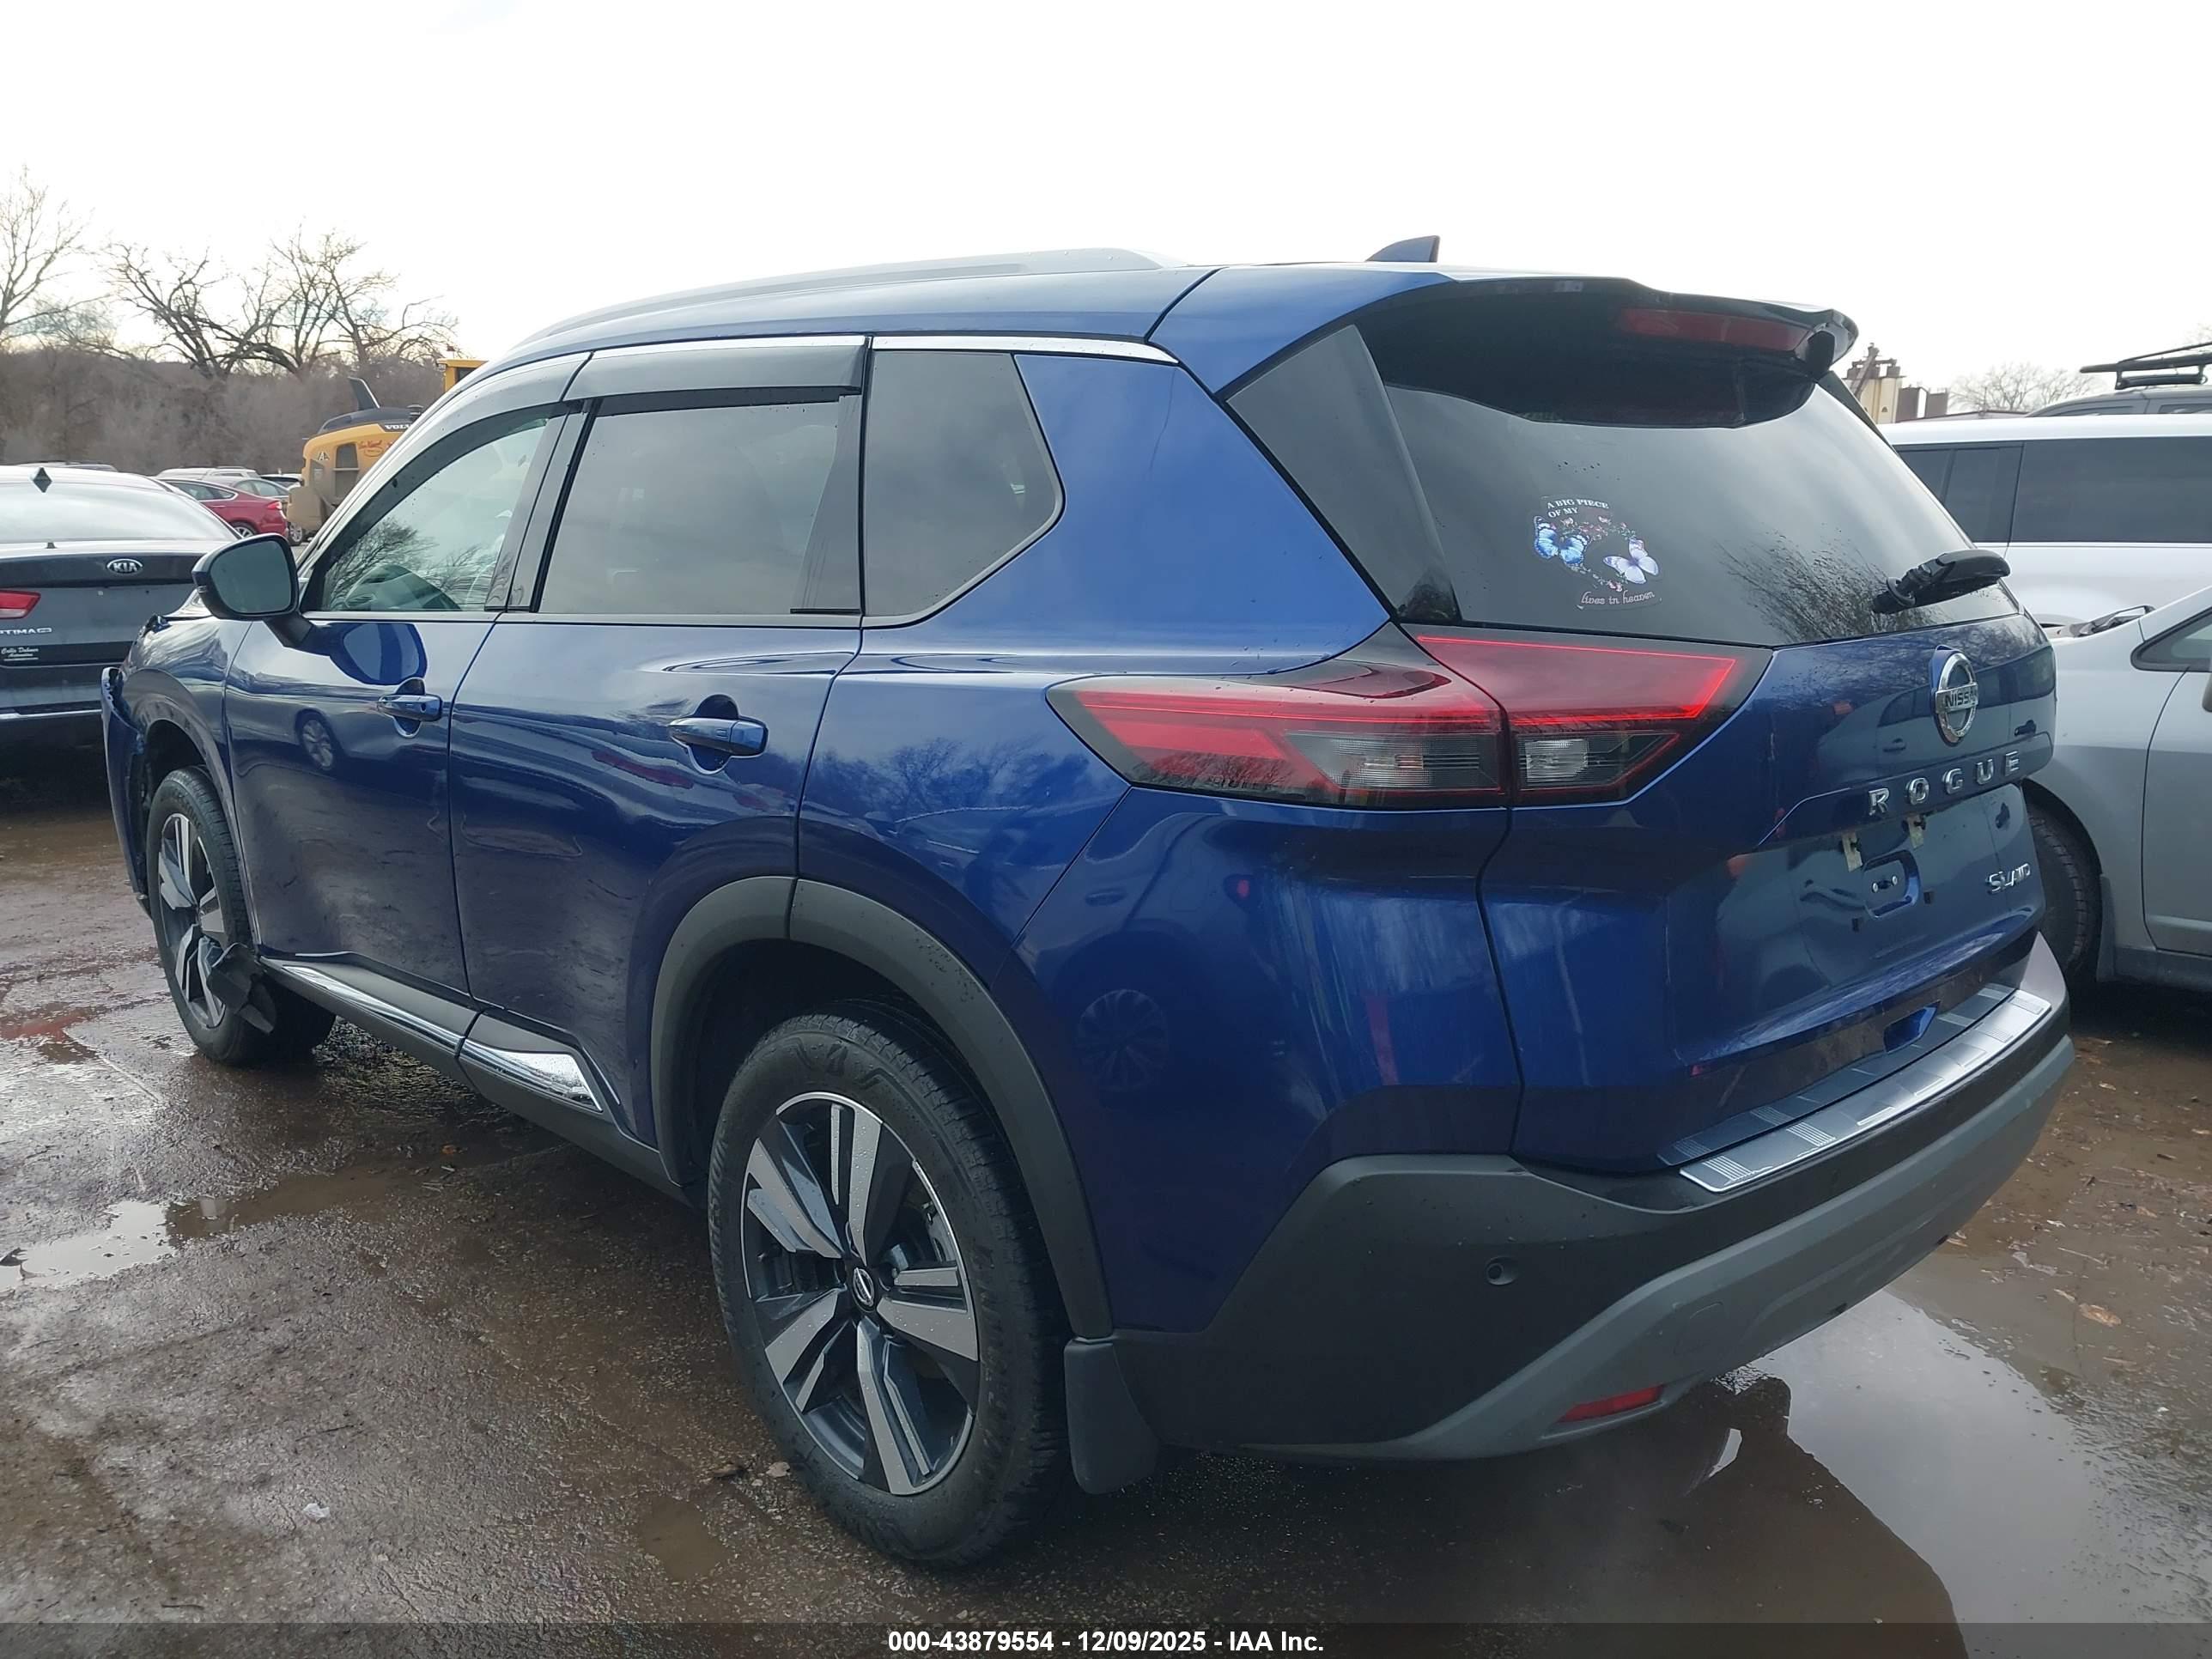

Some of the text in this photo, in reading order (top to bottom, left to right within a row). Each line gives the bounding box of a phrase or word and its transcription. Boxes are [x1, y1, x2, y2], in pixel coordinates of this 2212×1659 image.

[1577, 499, 1609, 509] PIECE
[1547, 507, 1578, 518] OF MY
[1608, 595, 1620, 605] in
[1622, 590, 1656, 605] heaven
[1868, 750, 2021, 816] ROGUE
